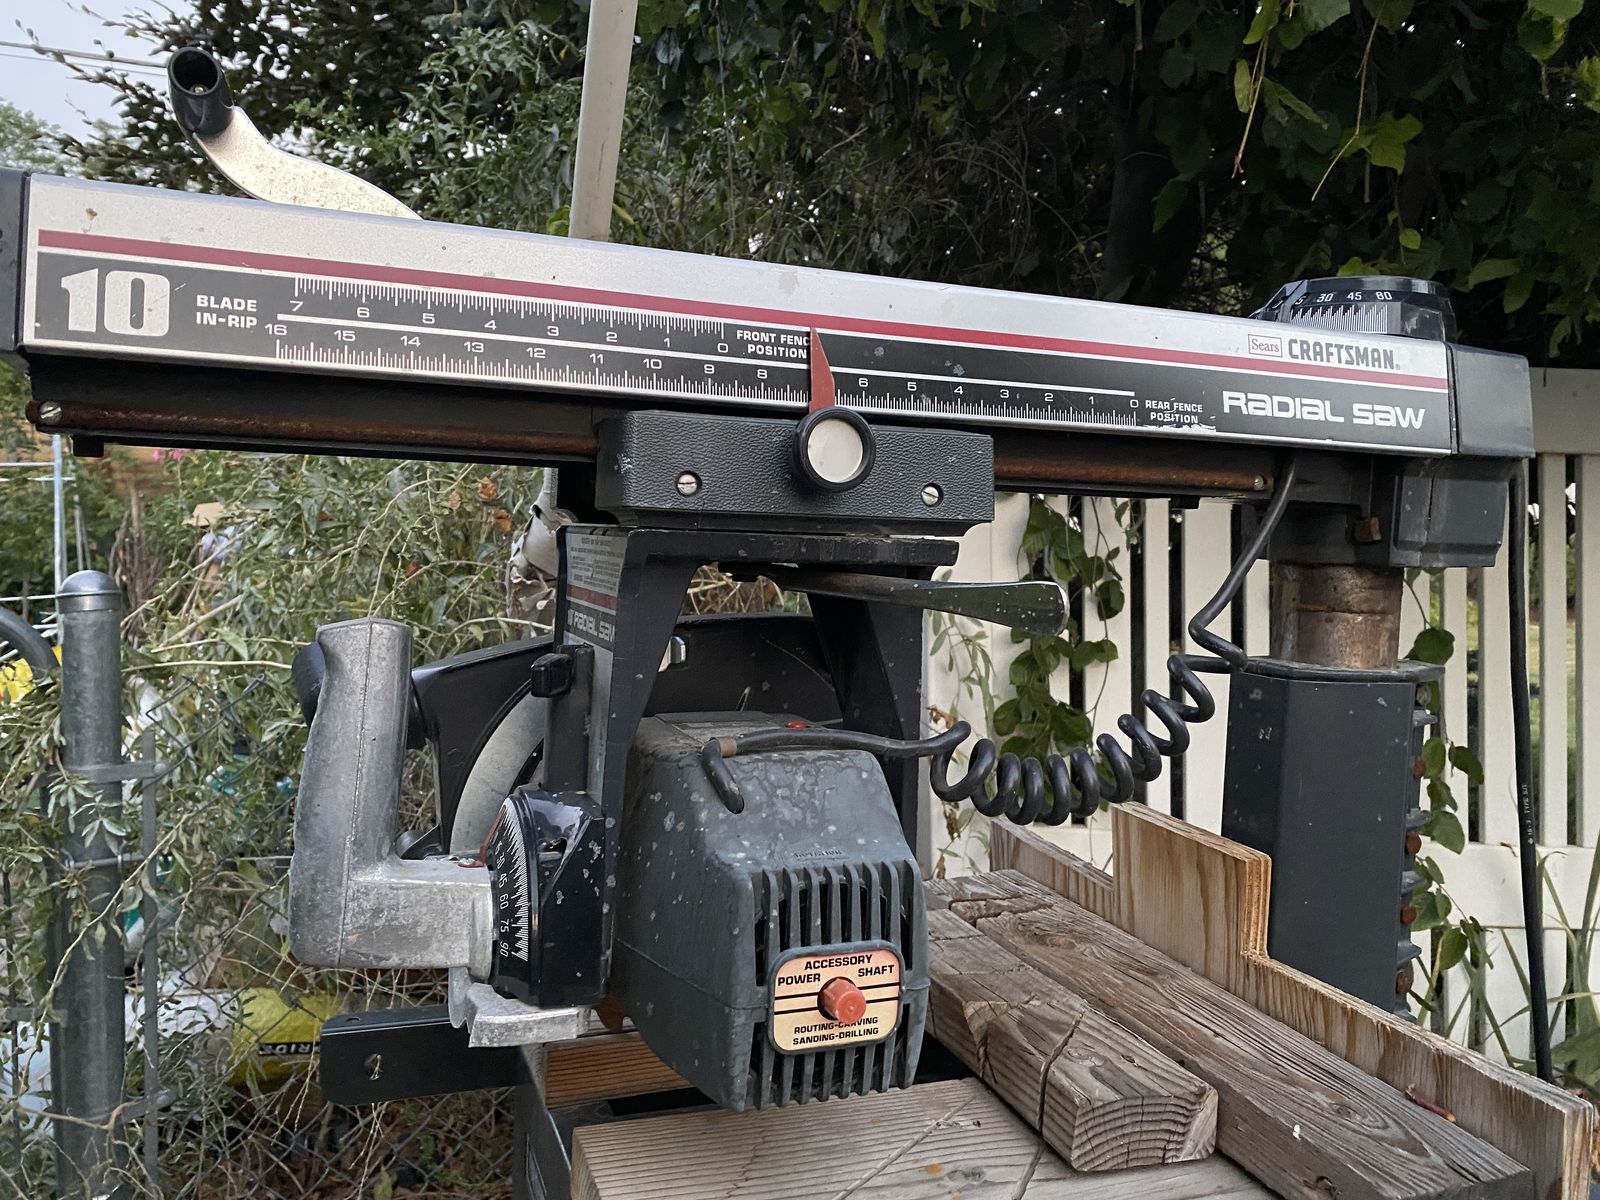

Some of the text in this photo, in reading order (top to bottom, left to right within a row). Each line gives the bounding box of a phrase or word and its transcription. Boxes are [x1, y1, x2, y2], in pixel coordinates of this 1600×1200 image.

[60, 268, 171, 336] 10
[196, 294, 258, 312] BLADE
[1316, 293, 1334, 303] 30
[1347, 291, 1362, 301] 45
[1376, 291, 1393, 300] 60
[196, 313, 258, 328] IN-RIP
[290, 300, 729, 354] 7 6 5 4 3 2 1 0
[736, 329, 810, 347] FRONT FENC
[747, 343, 808, 359] POSITION
[1250, 338, 1395, 368] Sears CRAFTSMAN
[264, 323, 1139, 408] 16 15 14 13 12 11 10 9 8 6 5 4 3 2 1 0
[1145, 399, 1204, 413] REAR FENCE
[1150, 411, 1199, 424] POSITION
[498, 873, 508, 889] 45
[499, 893, 508, 910] 60
[500, 919, 510, 933] 75
[500, 940, 509, 958] 90
[804, 954, 873, 971] ACCESSORY
[777, 964, 895, 987] POWER SHAFT
[794, 1016, 879, 1035] ROUTING-CVING
[793, 1027, 879, 1045] SANDING-DRILLING
